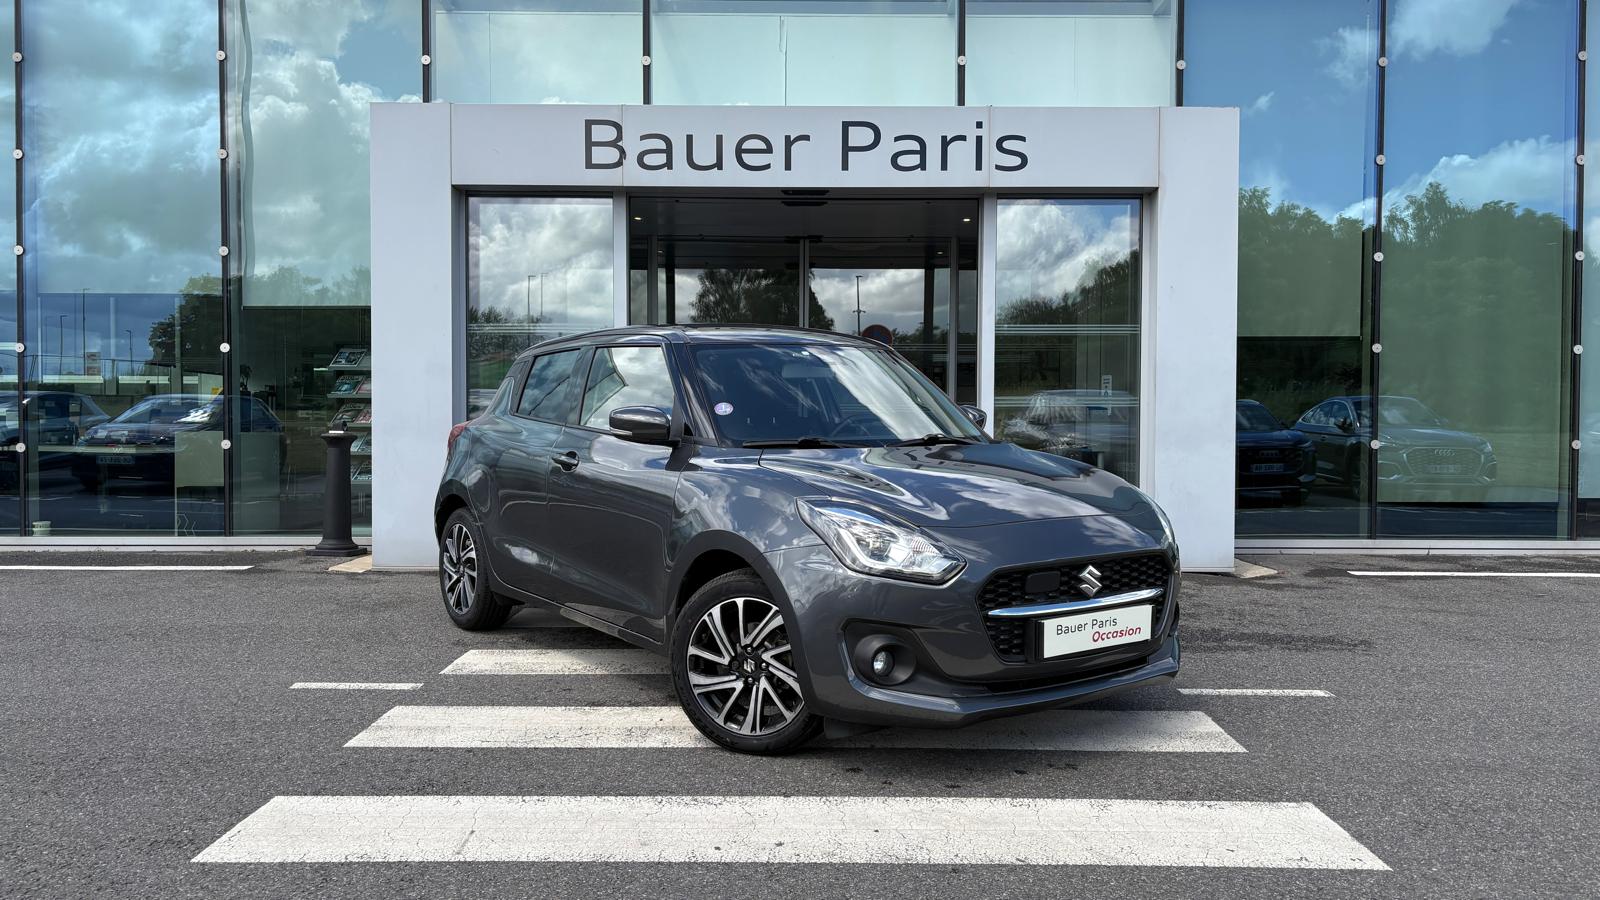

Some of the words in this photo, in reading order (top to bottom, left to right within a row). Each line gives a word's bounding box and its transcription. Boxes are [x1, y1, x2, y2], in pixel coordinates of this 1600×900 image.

[584, 119, 810, 171] Bauer
[841, 120, 1029, 171] Paris
[1056, 623, 1088, 635] Bauer
[1091, 616, 1118, 629] Paris
[1092, 626, 1142, 642] Occasion
